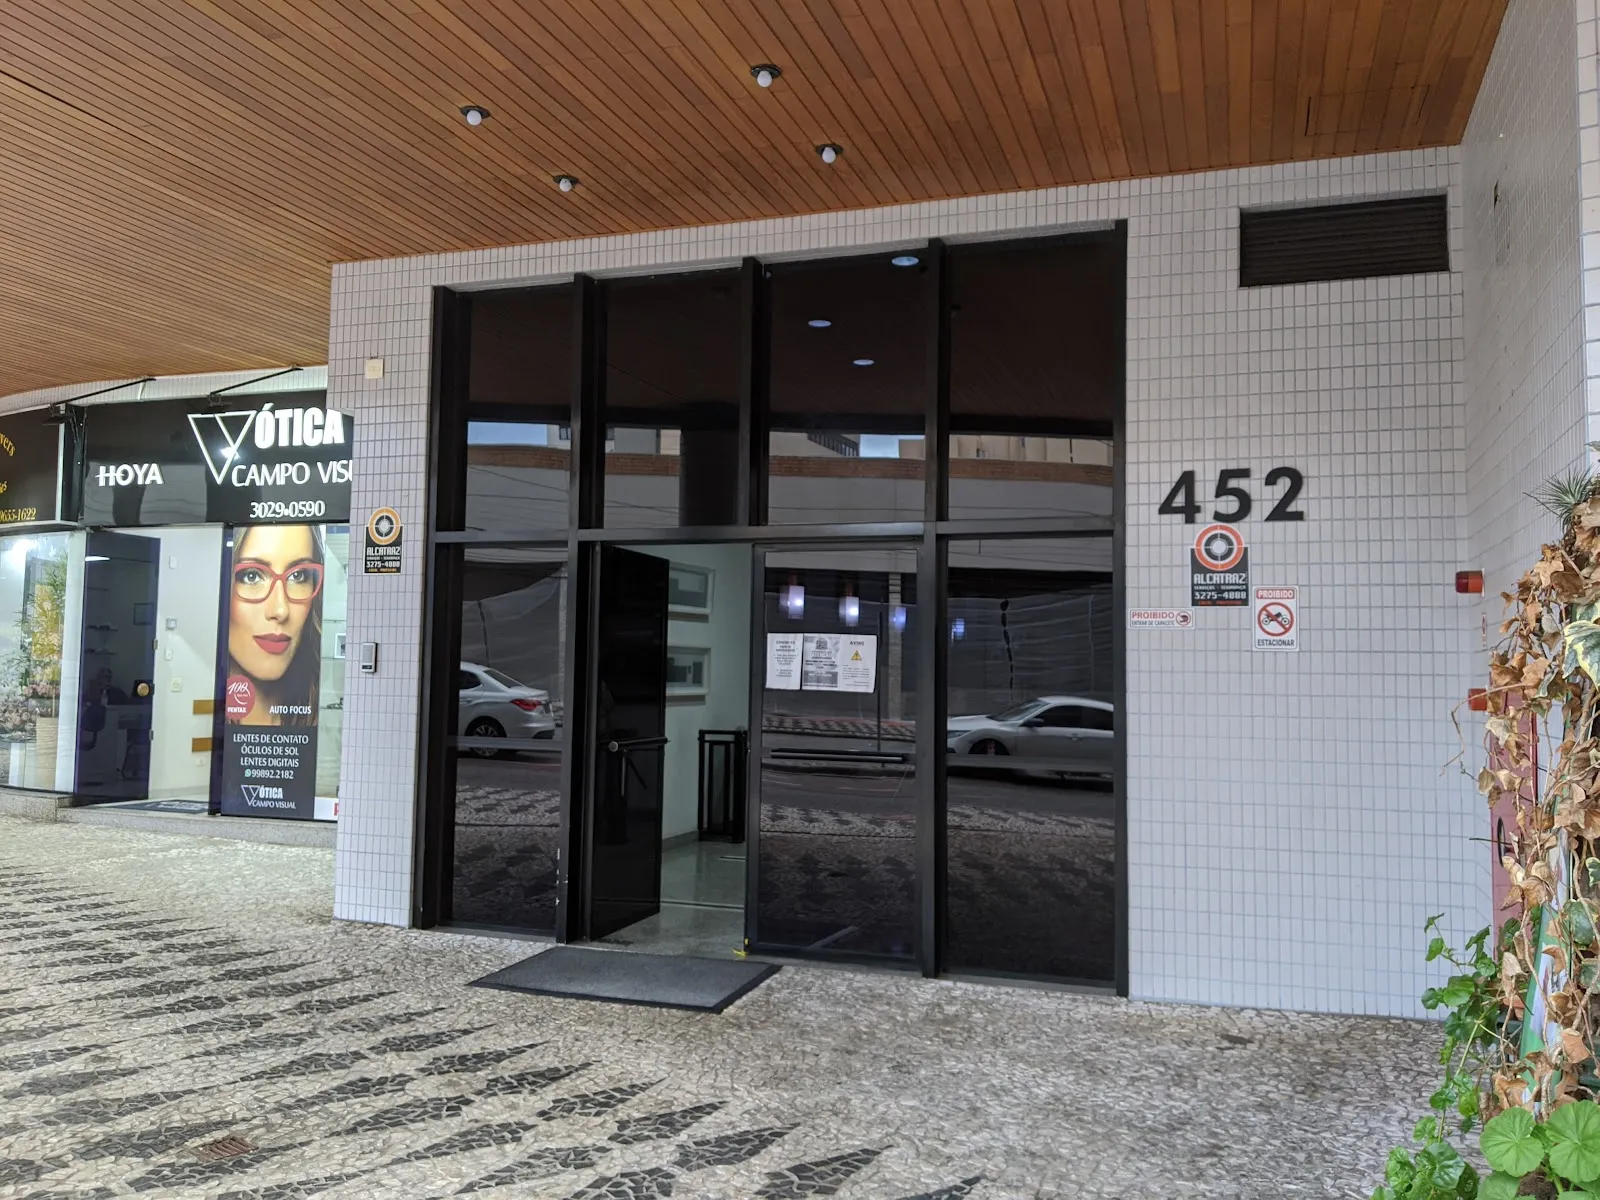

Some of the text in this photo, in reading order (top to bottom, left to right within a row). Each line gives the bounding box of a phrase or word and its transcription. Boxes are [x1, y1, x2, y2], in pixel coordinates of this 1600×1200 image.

[254, 402, 346, 450] ÓTICA
[95, 463, 164, 487] HOYA
[231, 463, 311, 488] CAMPO
[1158, 466, 1306, 525] 452
[366, 546, 401, 556] ALCATRAZ
[1193, 572, 1247, 585] ALCATRAZ
[1193, 591, 1247, 600] 3275-4888
[1257, 589, 1294, 599] PROIBIDO
[1131, 611, 1175, 619] PROIBIDO
[1257, 639, 1295, 647] ESTACIONAR
[269, 705, 312, 715] AUTO FOCUS
[233, 733, 309, 745] LENTES DE CONTATO
[241, 744, 300, 756] ÓCULOS DE SOL
[240, 757, 300, 768] LENTES DIGITAIS
[251, 769, 294, 779] 99892.2182
[259, 785, 284, 799] ÓTICA
[252, 800, 297, 809] CAMPO VISUAL
